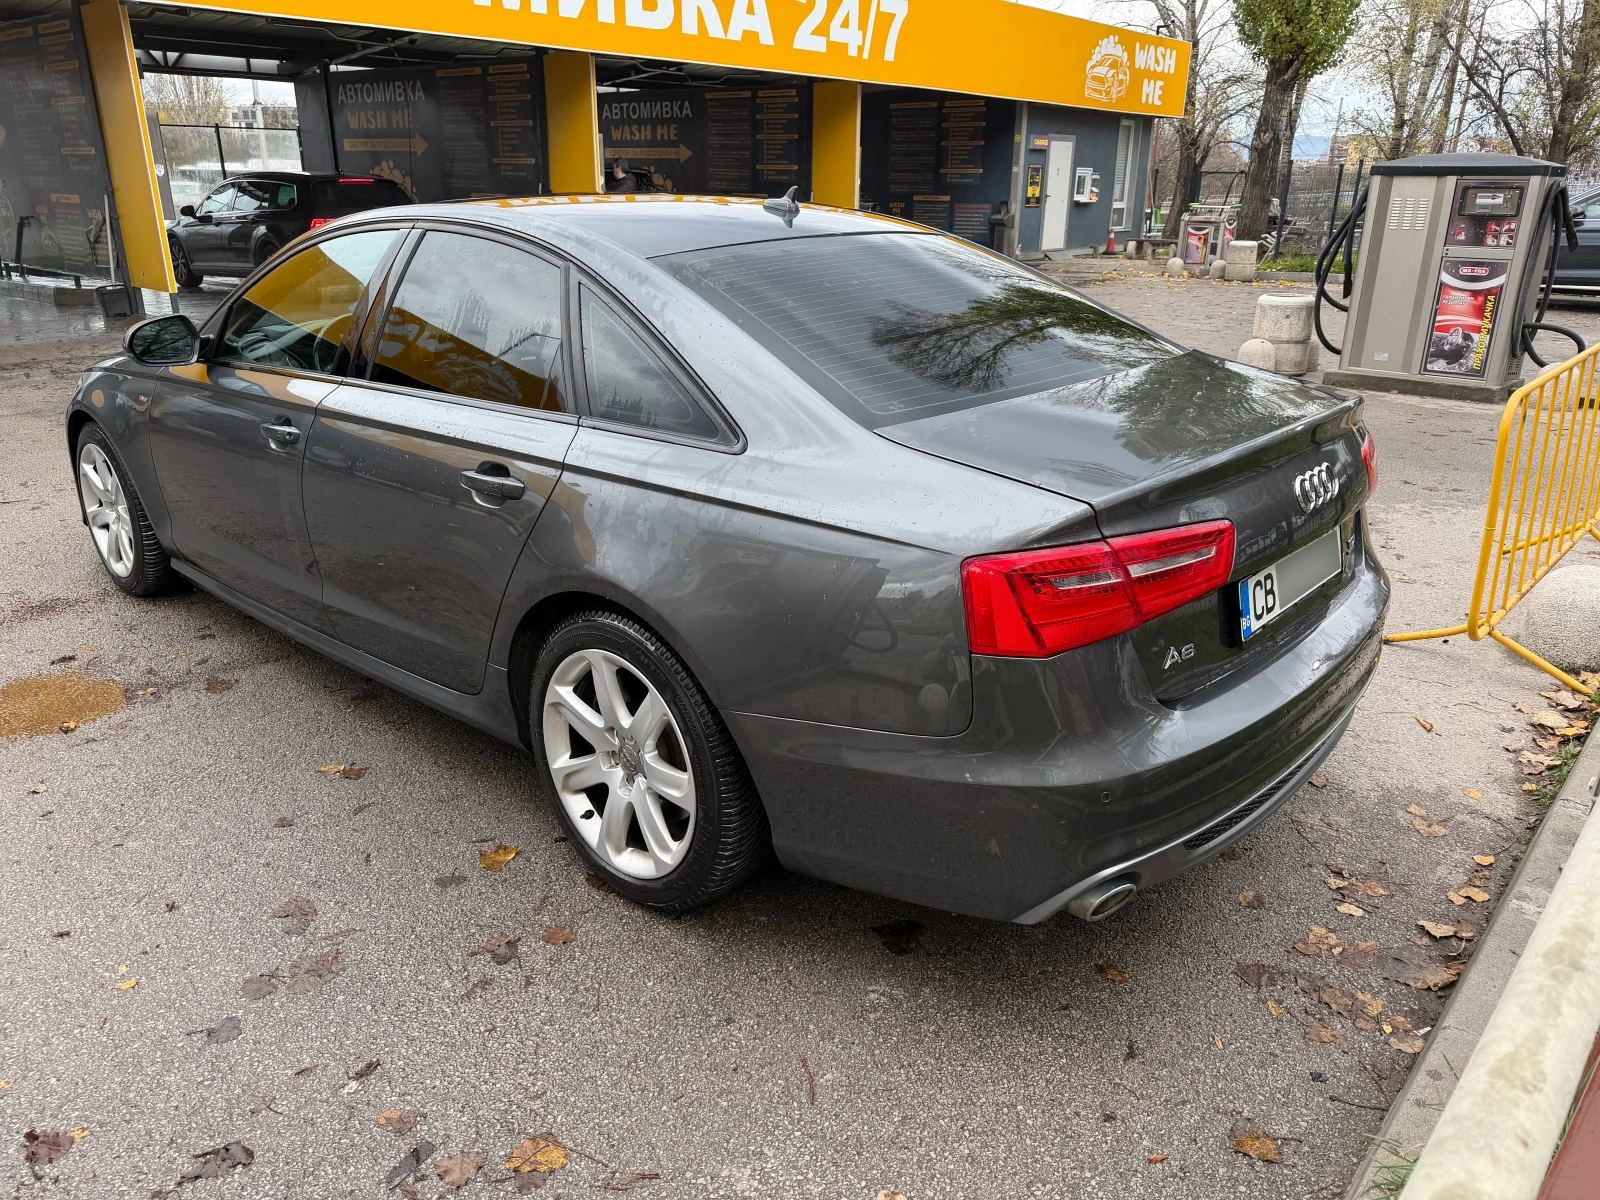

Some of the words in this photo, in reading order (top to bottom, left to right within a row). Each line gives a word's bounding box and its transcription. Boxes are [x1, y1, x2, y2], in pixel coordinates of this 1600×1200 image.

[793, 0, 908, 61] 24/7
[1134, 41, 1177, 74] WASH
[338, 80, 425, 104] АВТОМИВКА
[1141, 78, 1164, 105] ME
[347, 109, 388, 130] WASH
[391, 108, 413, 129] ME
[602, 100, 693, 119] АВТОМИВКА
[610, 124, 652, 140] WASH
[656, 124, 679, 140] ME
[1473, 295, 1496, 370] ПРАХОСМУКАЧКА
[1252, 572, 1276, 622] CB
[1242, 614, 1251, 630] BG
[1163, 643, 1195, 670] A6
